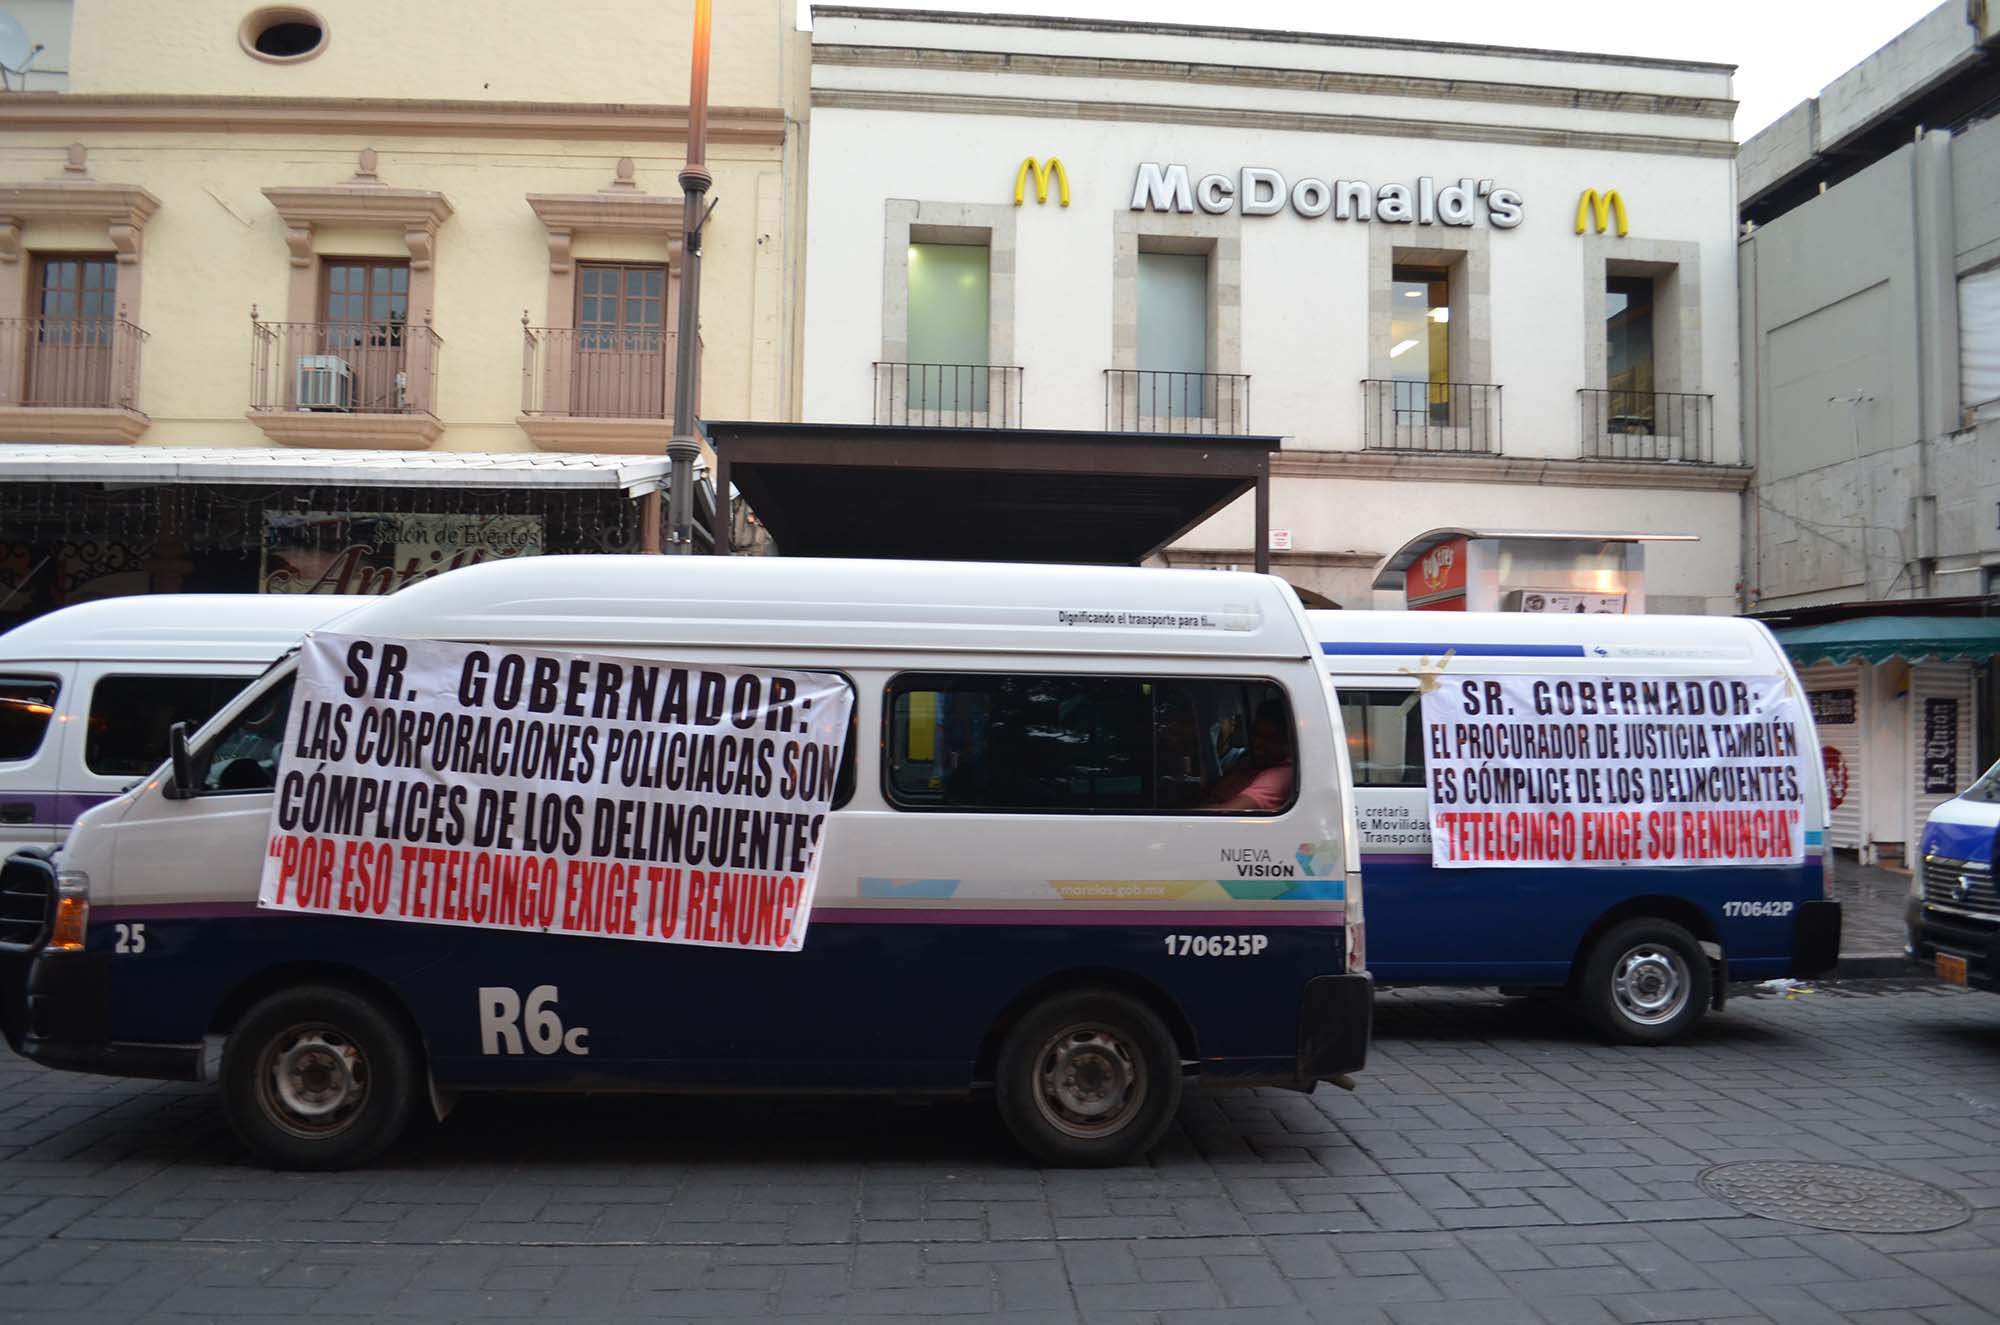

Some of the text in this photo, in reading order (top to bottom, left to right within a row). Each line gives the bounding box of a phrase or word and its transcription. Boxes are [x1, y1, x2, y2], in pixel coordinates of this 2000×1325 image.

[1130, 161, 1525, 230] McDonald's
[434, 522, 458, 545] de
[464, 524, 540, 545] Eventos
[1058, 610, 1115, 626] Dignificando
[1118, 612, 1126, 624] el
[1129, 613, 1176, 627] transporte
[1178, 615, 1198, 628] para
[344, 640, 812, 734] SR. GOBERNADOR:
[1461, 680, 1515, 716] SR.
[1533, 680, 1763, 717] GOBERNADOR:
[296, 700, 839, 802] LAS CORPORACIONES POLICIACAS SON
[1430, 716, 1798, 760] EL PROCURADOR DE JUSTICIA TAMBIÉN
[1432, 767, 1457, 804] ES
[1463, 761, 1572, 804] CÓMPLICE
[1576, 768, 1603, 804] DE
[1606, 767, 1645, 804] LOS
[1651, 765, 1804, 804] DELINCUENTES,
[278, 762, 468, 847] CÓMPLICES
[474, 788, 517, 850] DE
[523, 791, 584, 856] LOS
[1220, 849, 1272, 862] NUEVA
[1582, 811, 1642, 862] EXIGE
[1647, 810, 1676, 861] SU
[338, 840, 393, 915] ESO
[400, 845, 558, 928] TETELCINGO
[563, 860, 640, 936] EXIGE
[646, 866, 682, 939] TU
[1236, 860, 1294, 877] VISIÓN
[1722, 901, 1793, 917] 170642P
[115, 923, 145, 954] 25
[1164, 934, 1268, 957] 170625P
[478, 984, 589, 1056] R6c
